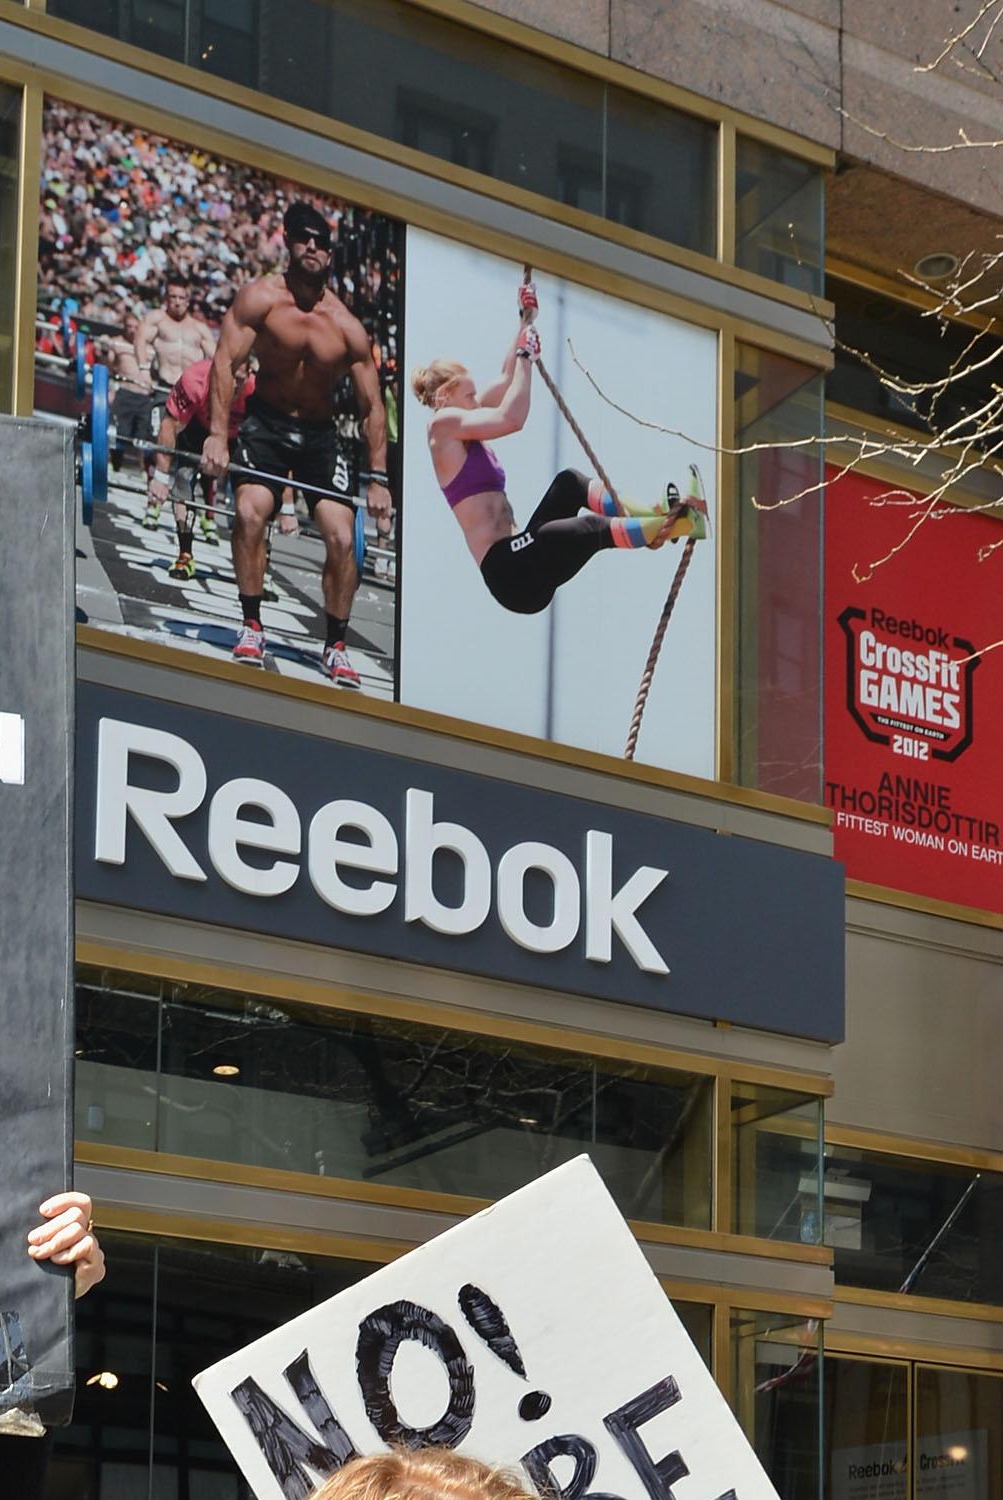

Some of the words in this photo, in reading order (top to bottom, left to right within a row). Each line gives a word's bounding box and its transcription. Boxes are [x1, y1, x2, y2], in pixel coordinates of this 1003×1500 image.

[870, 607, 950, 650] Reebok
[859, 630, 960, 691] CrossFit
[859, 669, 960, 729] GAMES
[877, 716, 889, 726] THE
[889, 719, 914, 732] FITTEST
[914, 726, 925, 735] ON
[924, 728, 945, 740] EARTH
[892, 734, 929, 761] 2012
[826, 781, 1000, 846] THORISDOTTIR
[877, 771, 952, 810] ANNIE
[94, 717, 671, 975] Reebok
[837, 812, 889, 837] FITTEST
[892, 825, 944, 851] WOMAN
[948, 839, 968, 857] ON
[971, 844, 1003, 866] EART
[848, 1460, 897, 1480] Reebok
